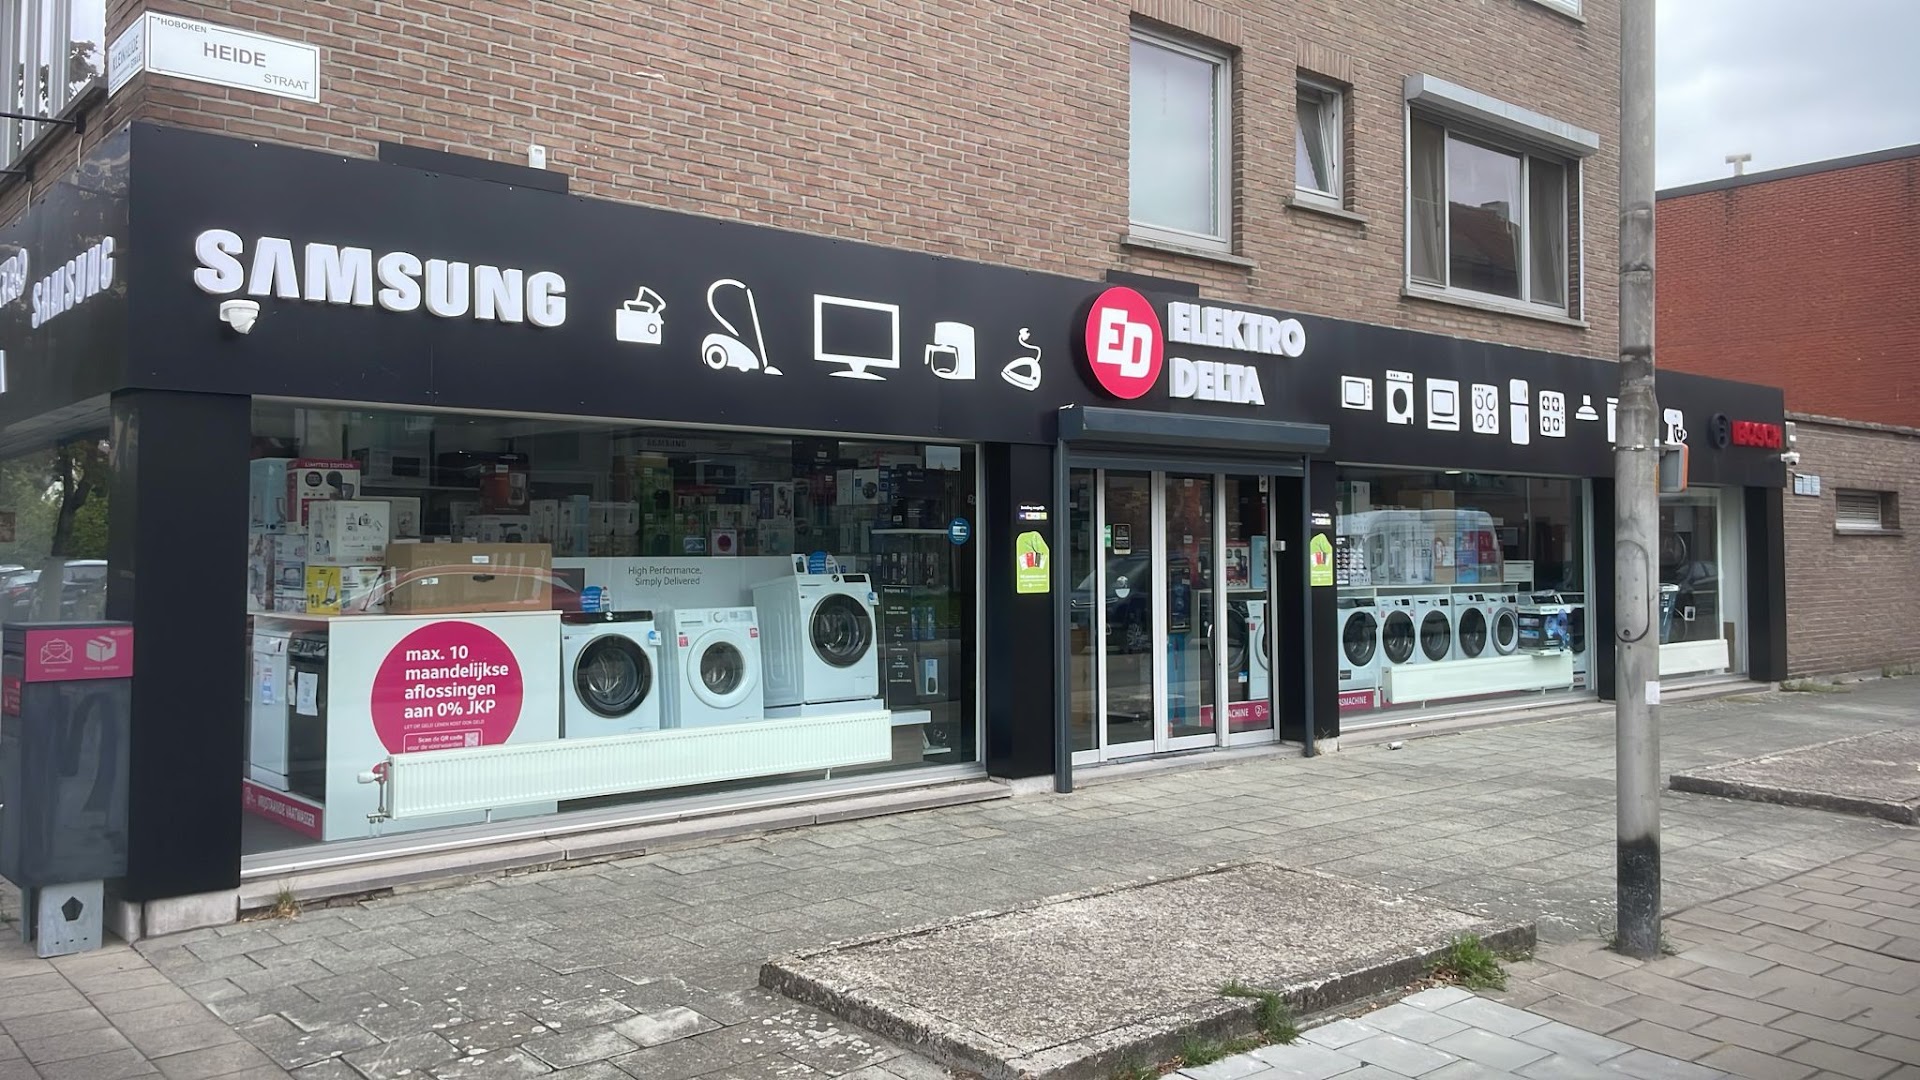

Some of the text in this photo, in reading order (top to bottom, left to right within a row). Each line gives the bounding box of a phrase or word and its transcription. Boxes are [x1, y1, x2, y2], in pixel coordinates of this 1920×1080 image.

[160, 18, 207, 33] HOBOKEN
[203, 41, 266, 68] HEIDE
[263, 73, 310, 91] STRAAT
[31, 236, 116, 329] SAMSUNG
[193, 228, 567, 328] SAMSUNG
[1167, 301, 1306, 358] ELEKTRO
[1097, 306, 1153, 378] ED
[1169, 357, 1266, 406] DELTA
[1731, 420, 1782, 449] BOSCH
[628, 566, 647, 577] High
[635, 576, 661, 587] Simply
[405, 645, 469, 661] max. 10
[405, 657, 509, 681] maandelijkse
[404, 682, 496, 700] aflossingen
[404, 699, 496, 719] aan 0% JKP
